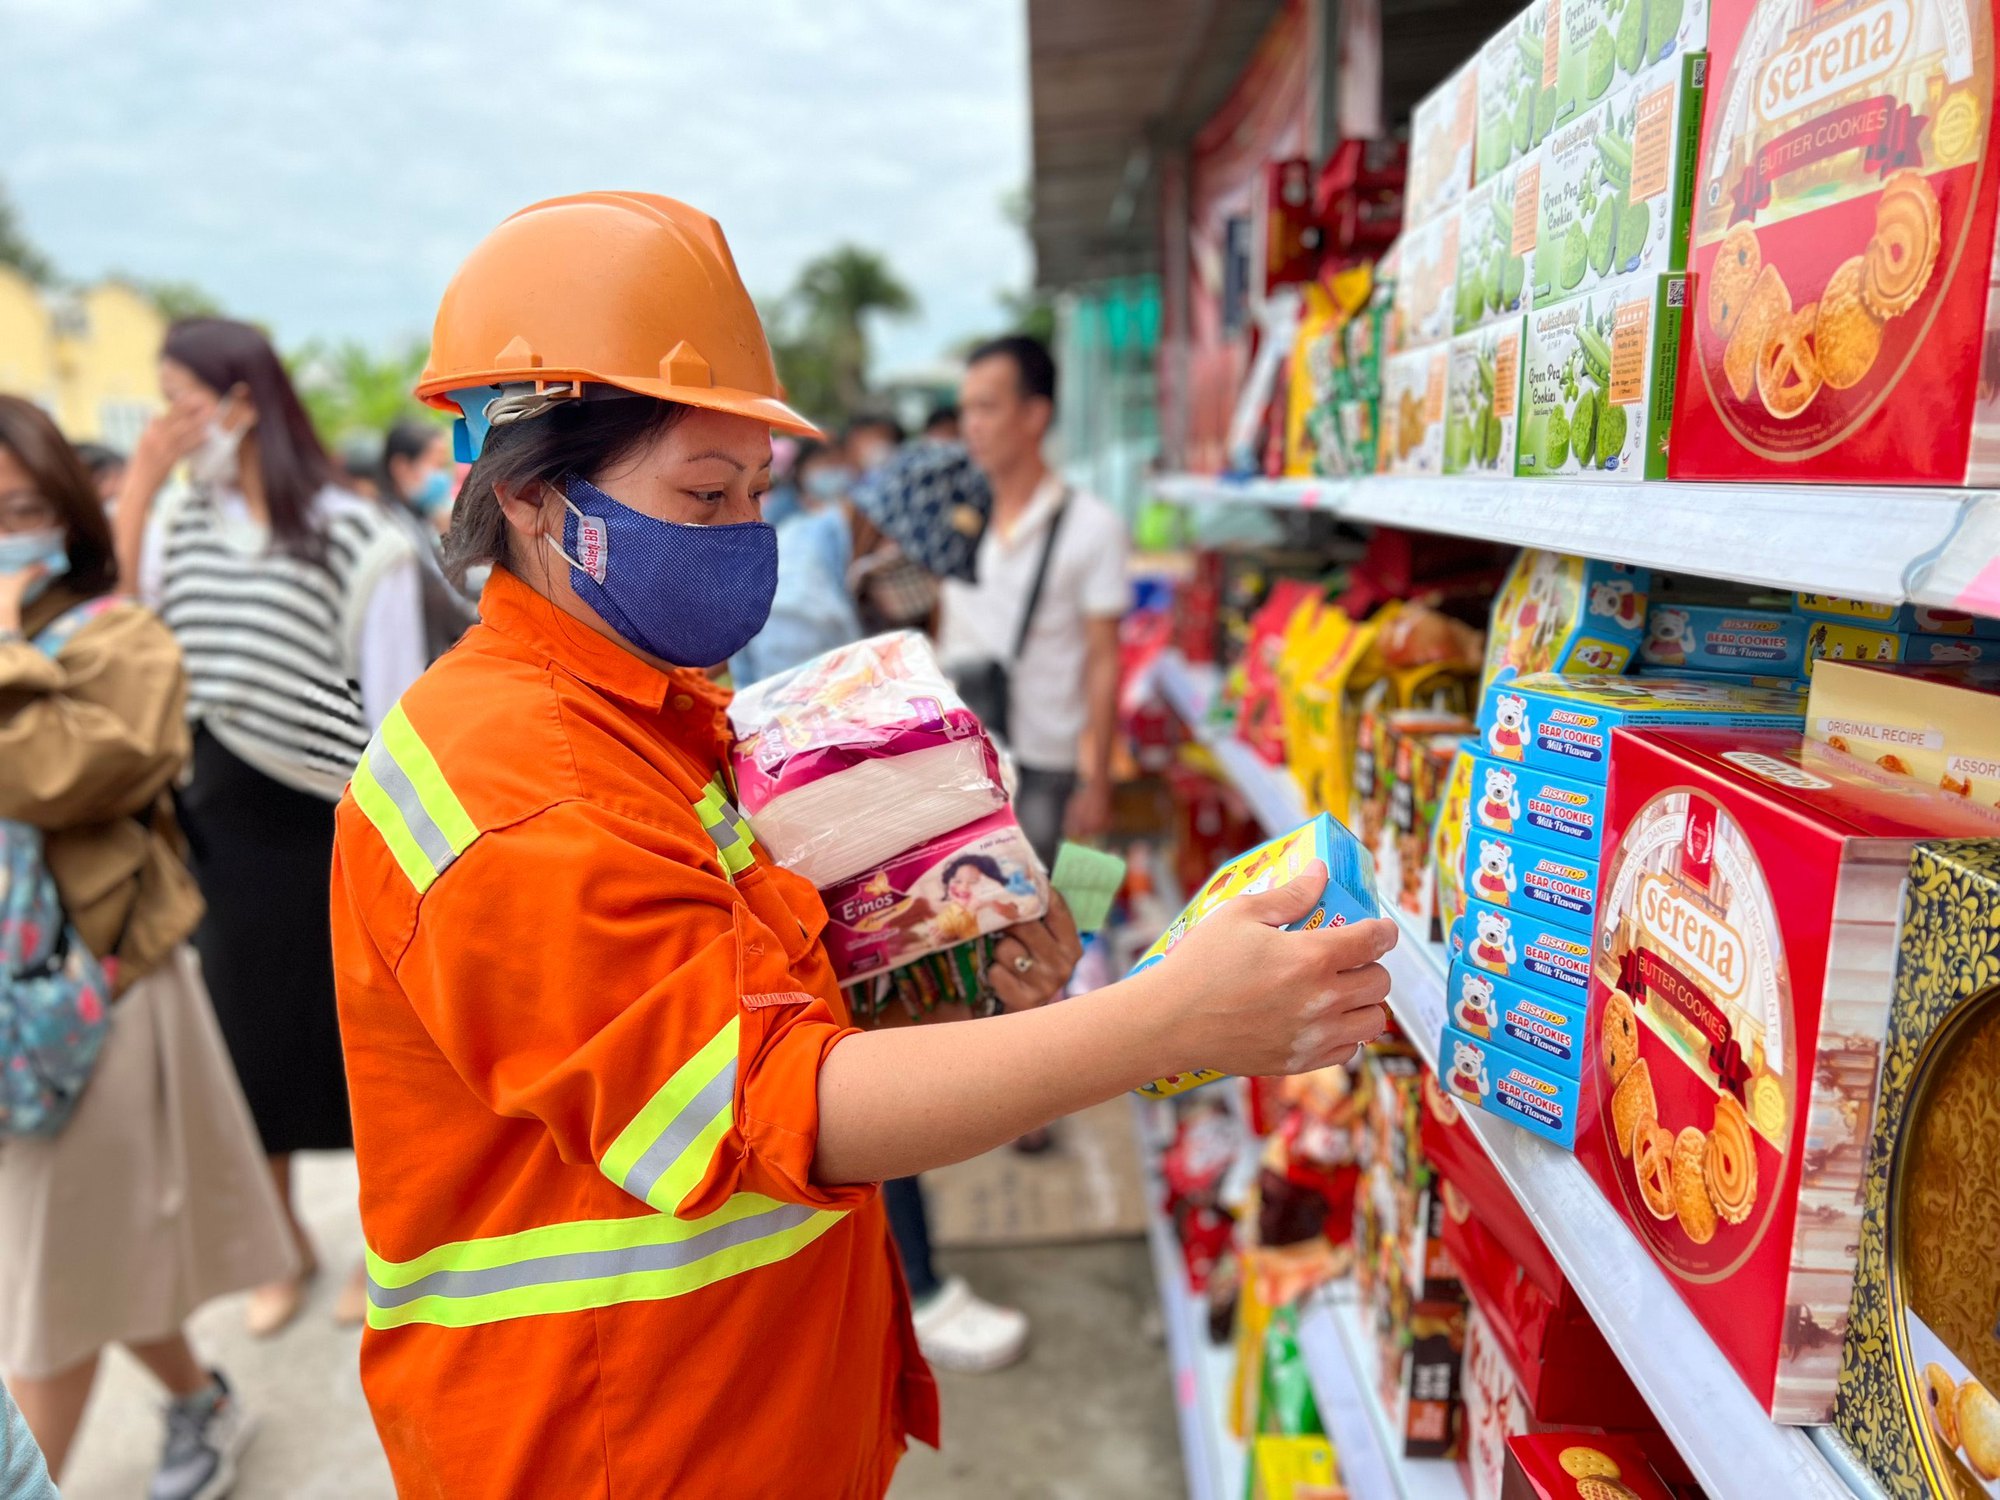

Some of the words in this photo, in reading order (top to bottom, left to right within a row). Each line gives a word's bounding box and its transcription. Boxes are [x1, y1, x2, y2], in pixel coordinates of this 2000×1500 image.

[1765, 9, 1895, 110] serena
[1759, 133, 1812, 176] BUTTER
[1816, 109, 1888, 147] COOKIES
[1548, 209, 1573, 230] Cookies
[1529, 367, 1546, 389] Green
[1547, 363, 1561, 381] Pea
[1532, 389, 1556, 406] Cookies
[1719, 619, 1780, 632] BISKITOP
[1706, 632, 1735, 643] BEAR
[1737, 636, 1787, 647] COOKIES
[1717, 645, 1737, 656] Milk
[1739, 647, 1776, 659] Flavour
[1549, 709, 1598, 727] BISKITOP
[1539, 724, 1562, 738] BEAR
[1563, 729, 1602, 747] COOKIES
[1827, 720, 1878, 739] ORIGINAL
[1881, 728, 1926, 746] RECIPE
[1546, 739, 1563, 752] Milk
[1564, 743, 1594, 759] Flavour
[1539, 786, 1588, 805] BISKITOP
[1529, 799, 1552, 814] BEAR
[1553, 806, 1593, 826] COOKIES
[1536, 815, 1553, 828] Milk
[1554, 820, 1584, 837] Flavour
[1647, 818, 1676, 845] DANISH
[1536, 860, 1586, 880] BISKITOP
[1525, 872, 1549, 888] BEAR
[1551, 880, 1591, 900] COOKIES
[841, 893, 894, 921] E'mos
[1533, 889, 1551, 902] Milk
[1551, 894, 1583, 911] Flavour
[1536, 934, 1588, 955] BISKITOP
[1645, 886, 1734, 984] serena
[1525, 945, 1550, 961] BEAR
[1552, 954, 1590, 974] COOKIE
[1723, 850, 1751, 902] FINEST
[1748, 908, 1780, 1048] INGREDIENTS
[1534, 962, 1552, 976] Milk
[1553, 968, 1586, 986] Flavour
[1638, 955, 1677, 995] BUTTER
[1677, 987, 1727, 1044] COOKIES
[1517, 1001, 1566, 1025] BISKITOP
[1506, 1011, 1530, 1028] BEAR
[1531, 1022, 1571, 1046] COOKIES
[1514, 1028, 1531, 1042] Milk
[1532, 1034, 1563, 1055] Flavour
[1508, 1069, 1556, 1094] BISKITOP
[1498, 1080, 1521, 1097] BEAR
[1523, 1091, 1562, 1116] COOKIES
[1506, 1096, 1523, 1111] Milk
[1523, 1104, 1554, 1125] Flavour
